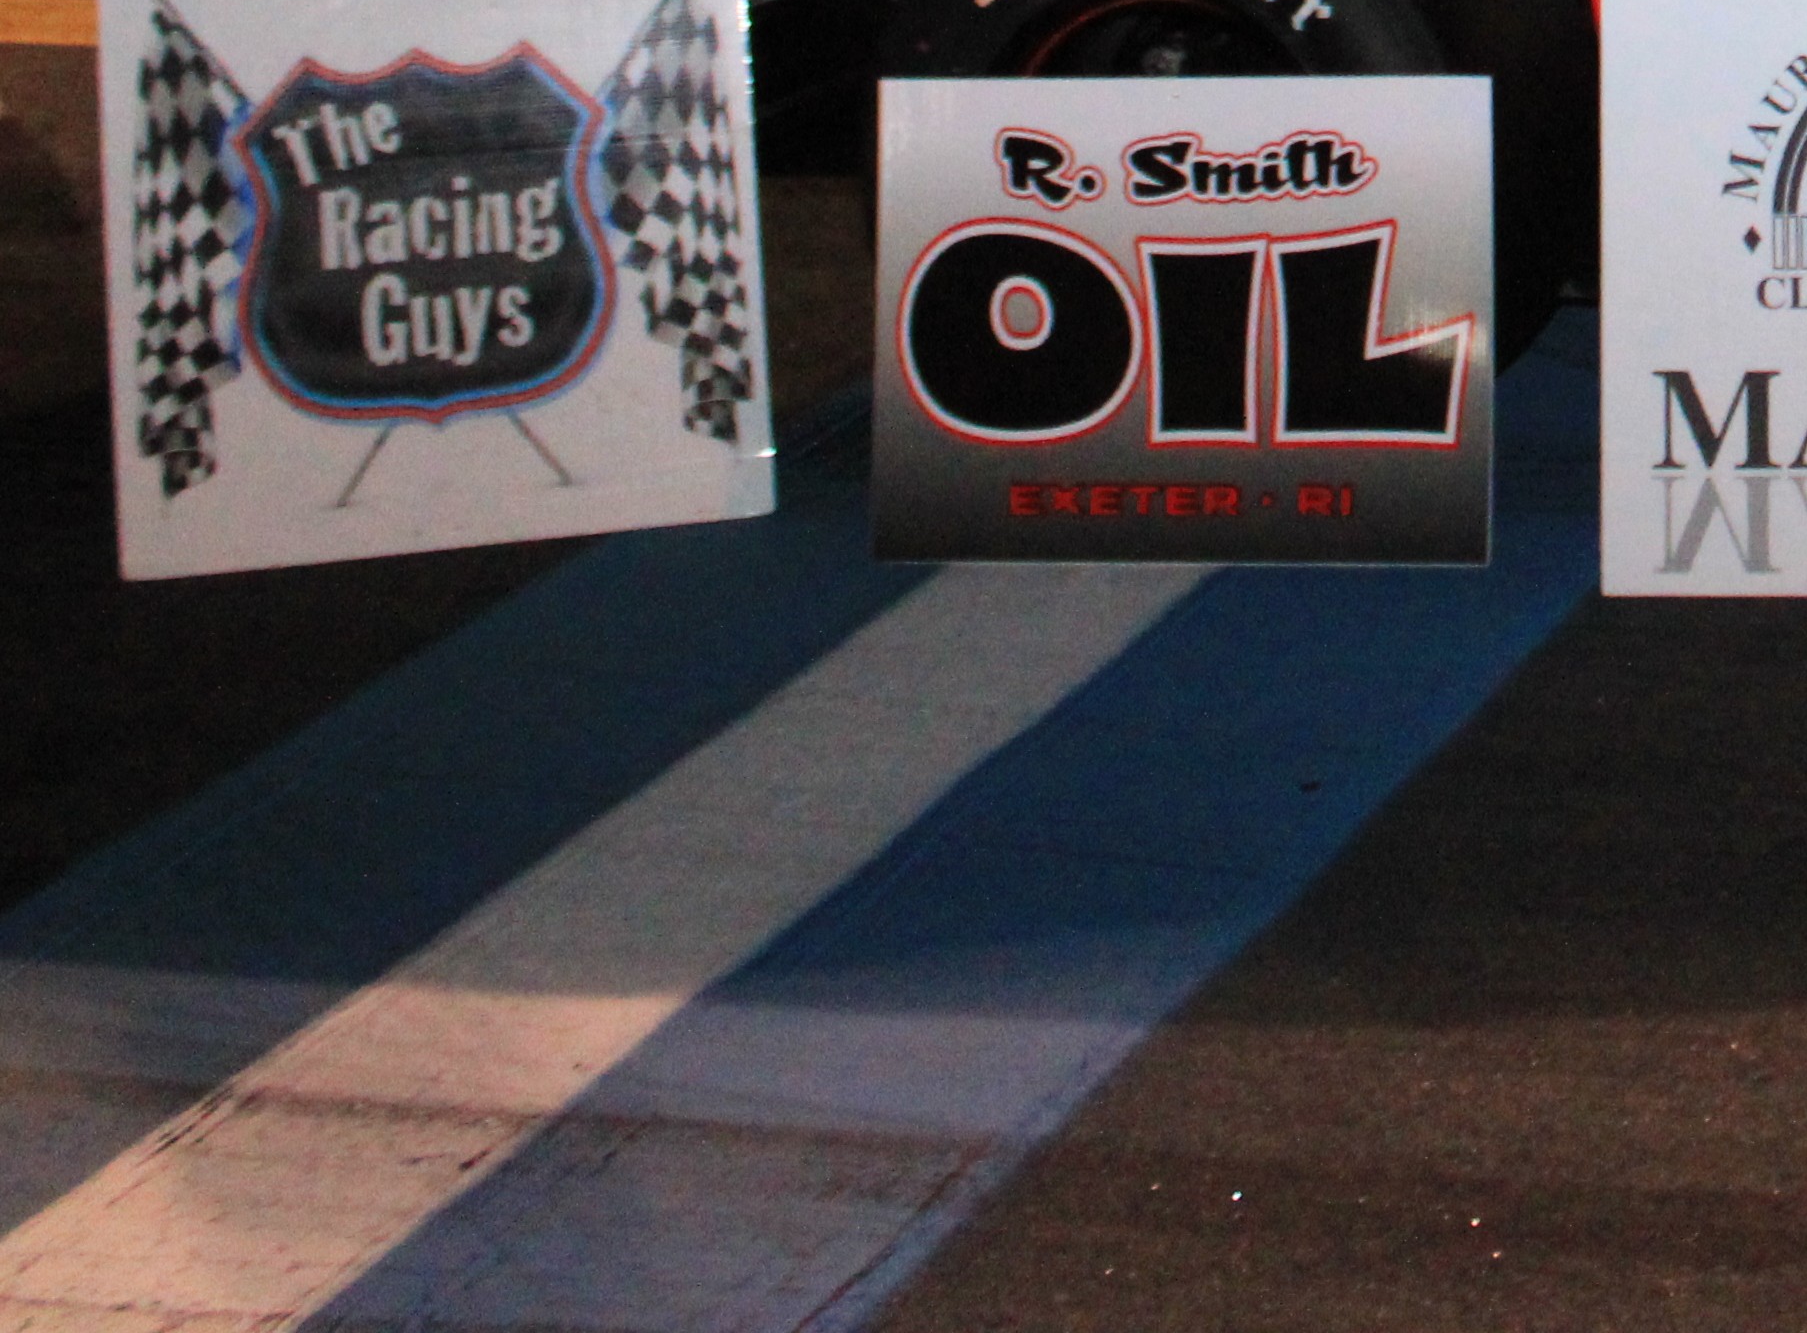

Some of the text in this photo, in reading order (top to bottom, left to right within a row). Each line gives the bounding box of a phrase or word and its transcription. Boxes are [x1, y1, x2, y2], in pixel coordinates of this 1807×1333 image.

[273, 102, 401, 187] The
[998, 132, 1370, 203] R. Smith
[319, 175, 566, 271] Racing
[361, 273, 534, 367] Guys
[903, 224, 1473, 446] OIL
[1009, 482, 1354, 518] EXETER RI
